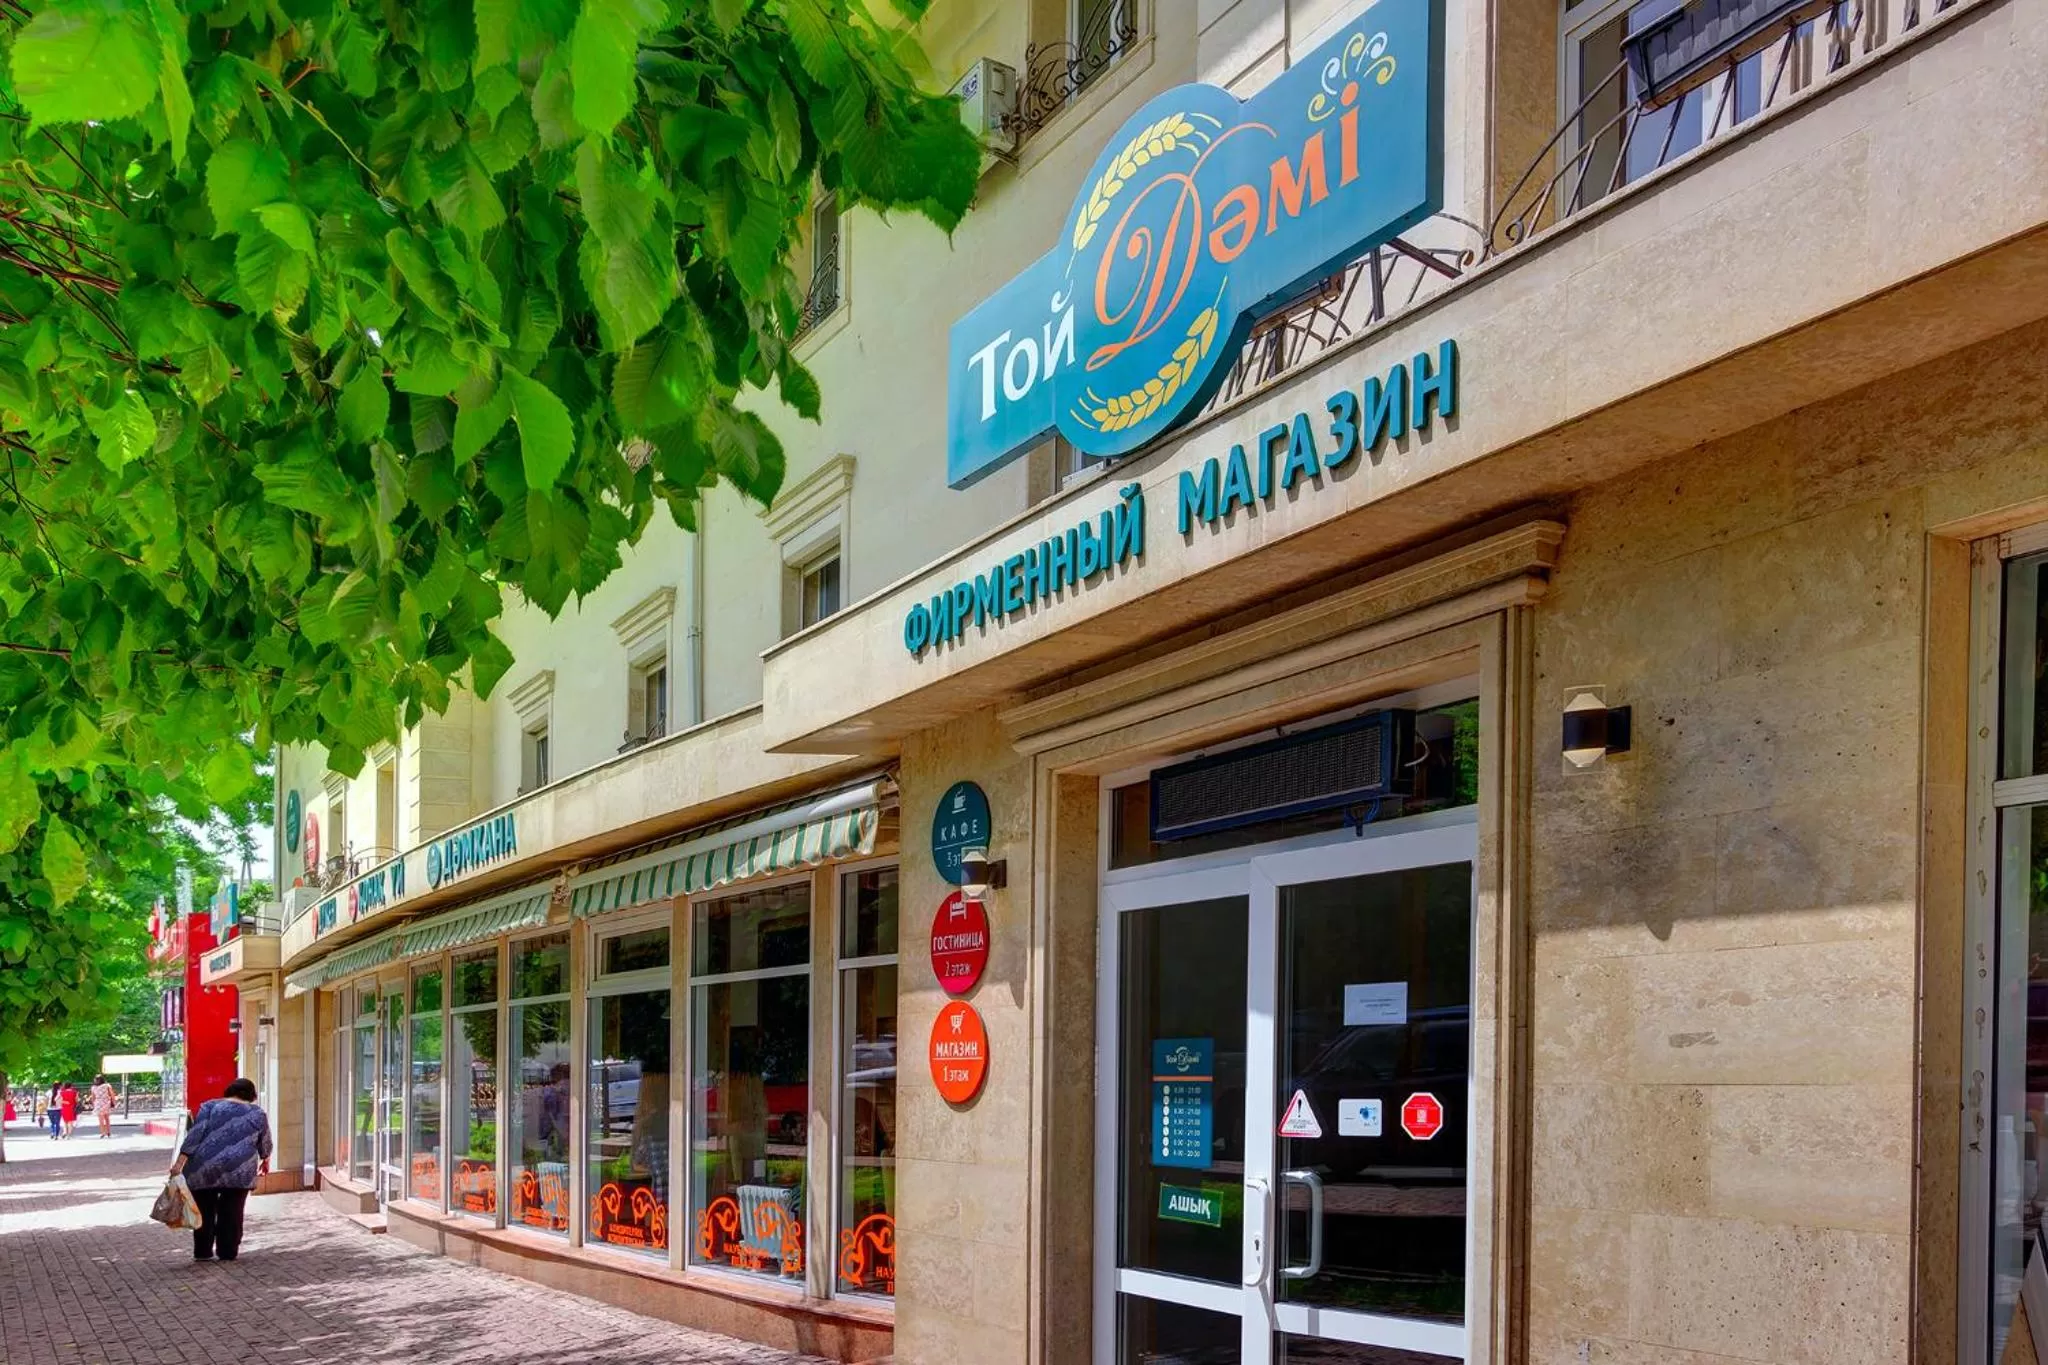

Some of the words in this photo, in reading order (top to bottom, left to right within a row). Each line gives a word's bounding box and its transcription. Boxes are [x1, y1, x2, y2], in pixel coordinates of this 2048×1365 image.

[968, 280, 1075, 422] Той
[1086, 82, 1360, 371] Дәмі
[904, 482, 1146, 655] ФИРМЕННЫЙ
[1178, 339, 1457, 534] МАГАЗИН
[940, 818, 979, 842] КАФЕ
[443, 812, 518, 880] ДӘМКАНА
[933, 932, 985, 951] ГОСТИНИЦА
[935, 1040, 978, 1058] МАГАЗИН
[1168, 1194, 1212, 1220] АШЫҚ
